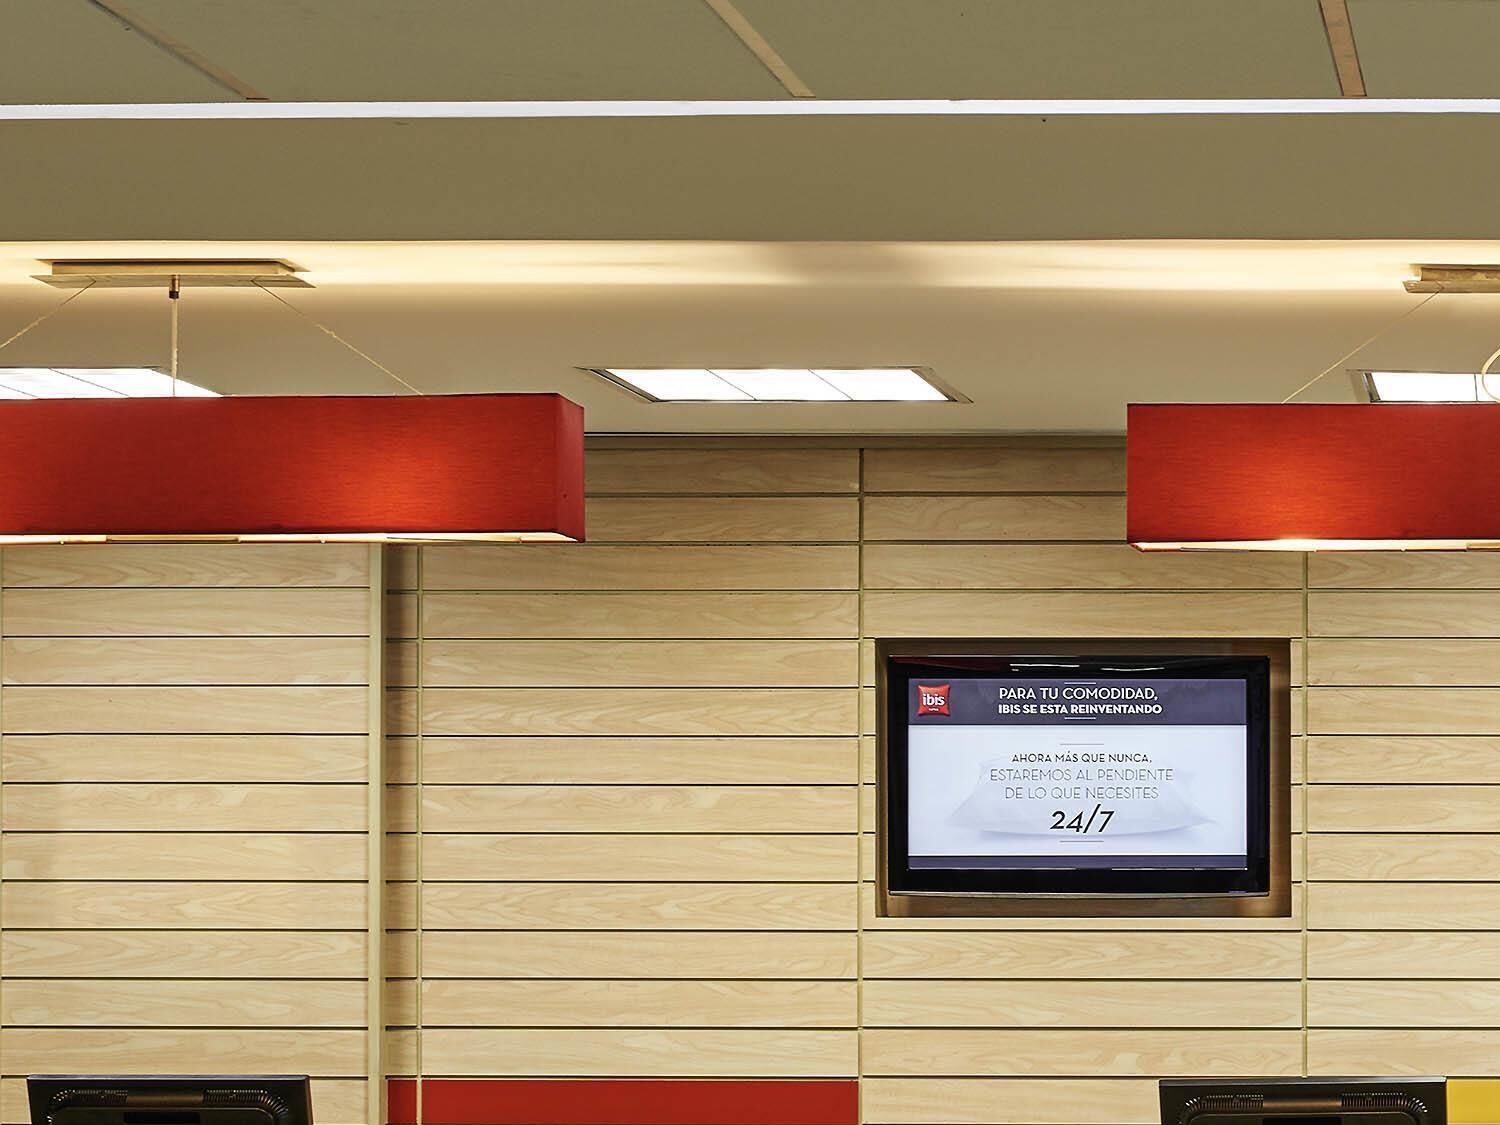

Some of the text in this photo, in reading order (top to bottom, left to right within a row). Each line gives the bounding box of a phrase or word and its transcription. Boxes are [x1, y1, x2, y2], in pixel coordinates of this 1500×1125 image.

[922, 692, 945, 706] ibis
[999, 686, 1158, 701] PARA TU COMODIDAD,
[1023, 704, 1038, 714] SE
[1040, 704, 1068, 714] ESTA
[1070, 704, 1162, 714] REINVENTANDO
[1012, 753, 1052, 763] AHORA
[1055, 750, 1079, 763] MÁS
[1081, 753, 1105, 763] QUE
[990, 768, 1173, 781] ESTAREMOS AL PENDIENTE
[1005, 787, 1159, 800] DE LO QUE NECESITES
[1050, 803, 1115, 834] 24/7
